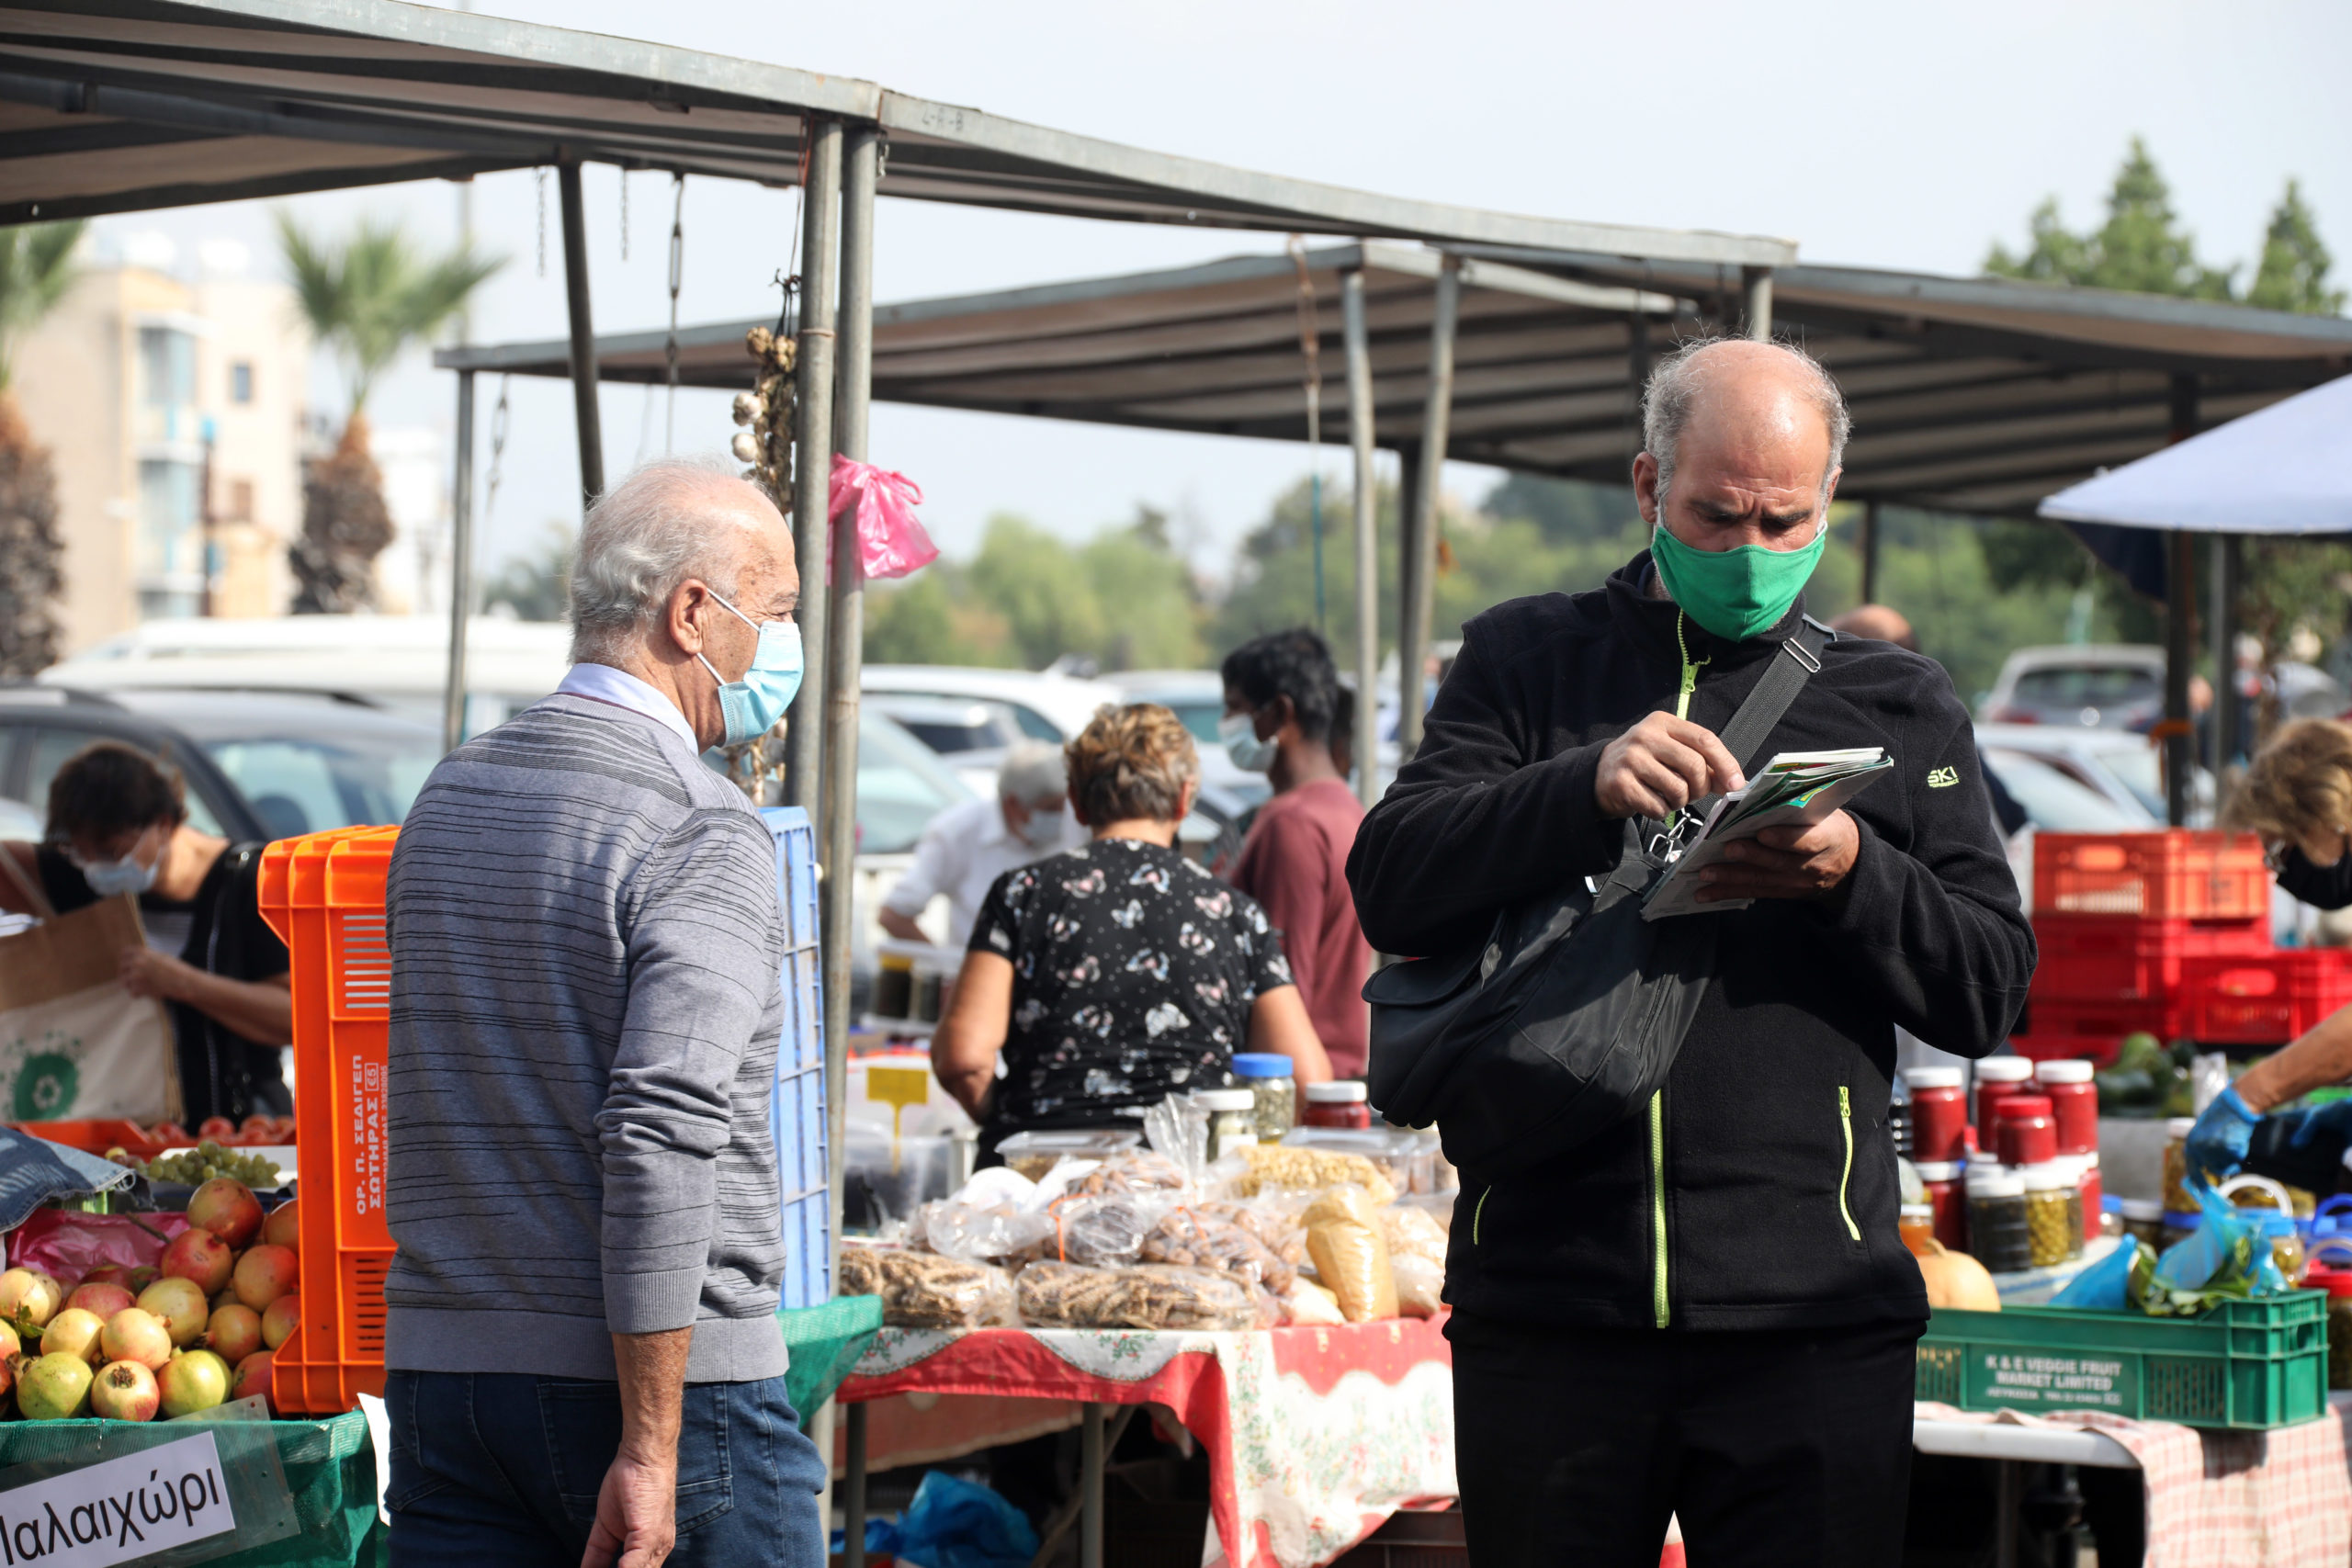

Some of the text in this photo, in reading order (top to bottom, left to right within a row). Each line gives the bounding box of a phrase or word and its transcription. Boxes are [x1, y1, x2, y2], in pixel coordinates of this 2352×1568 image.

[1928, 766, 1958, 783] SKI
[368, 1067, 378, 1087] €5
[353, 1055, 364, 1145] ΣΕΔΙΓΕΠ
[368, 1098, 381, 1209] ΣΩΤΗΡΑΣ
[1985, 1355, 2122, 1376] K & E VEGGIE FRUIT
[1996, 1371, 2112, 1391] MARKET LIMITED
